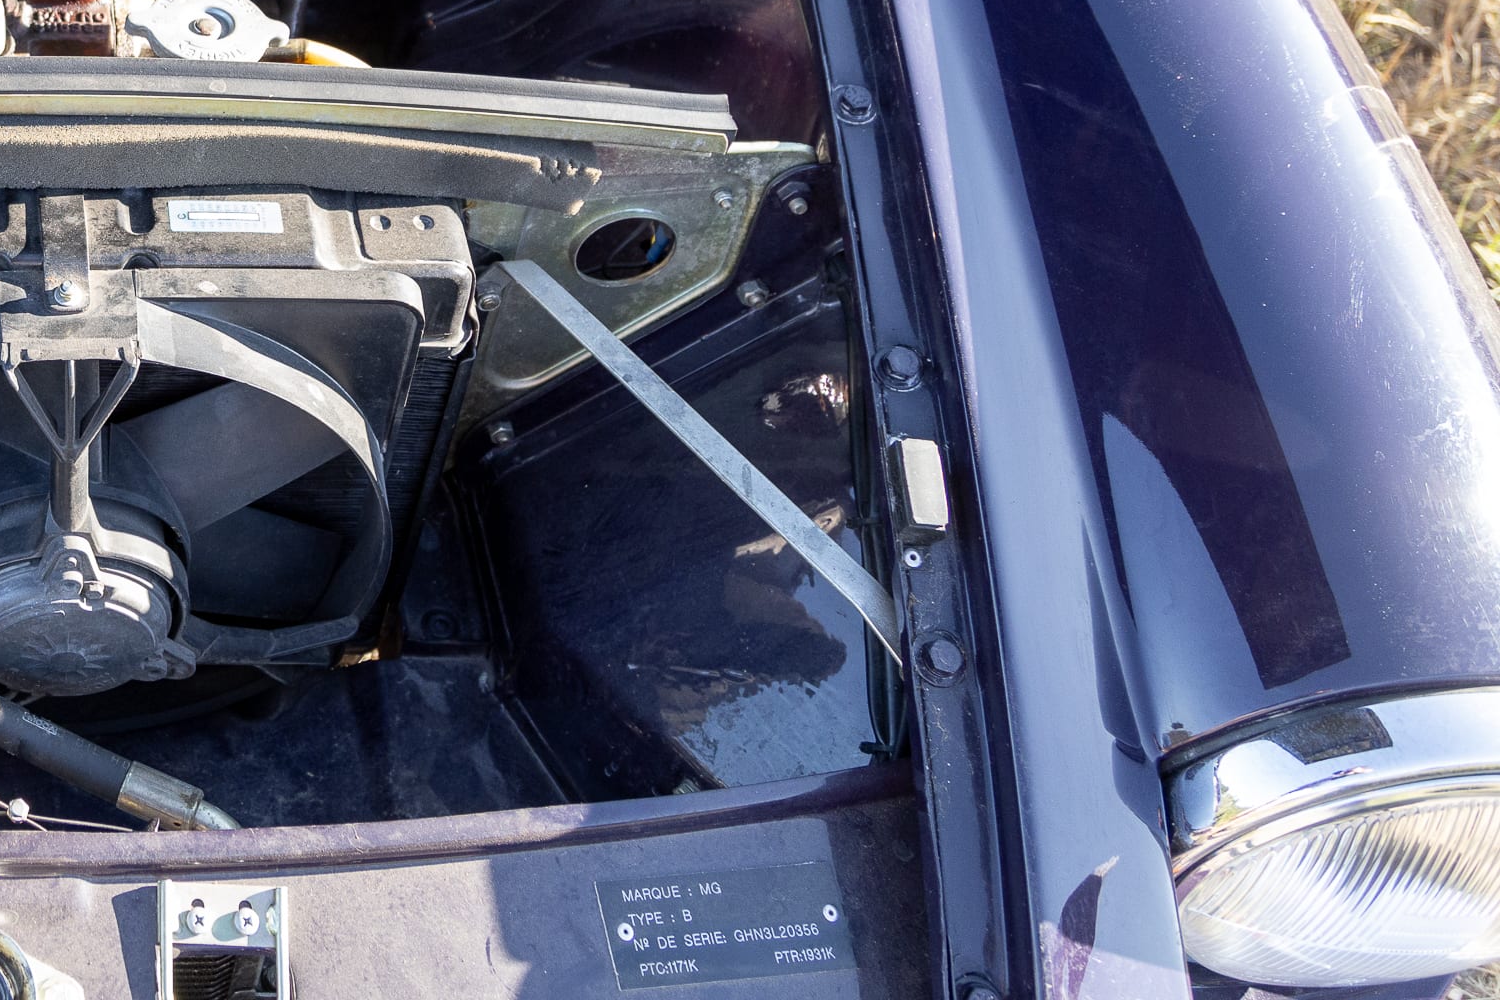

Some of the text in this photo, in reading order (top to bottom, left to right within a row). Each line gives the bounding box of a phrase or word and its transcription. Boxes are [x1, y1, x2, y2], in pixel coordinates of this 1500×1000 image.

[622, 886, 681, 902] MARQUE
[699, 882, 722, 895] MG
[628, 912, 664, 926] TYPE
[682, 909, 692, 922] B
[657, 935, 677, 949] DE
[684, 931, 727, 947] SERIE:
[734, 923, 820, 943] GHN3L20356
[774, 946, 836, 964] PTR:1931K
[639, 959, 699, 977] PTC:1171K
